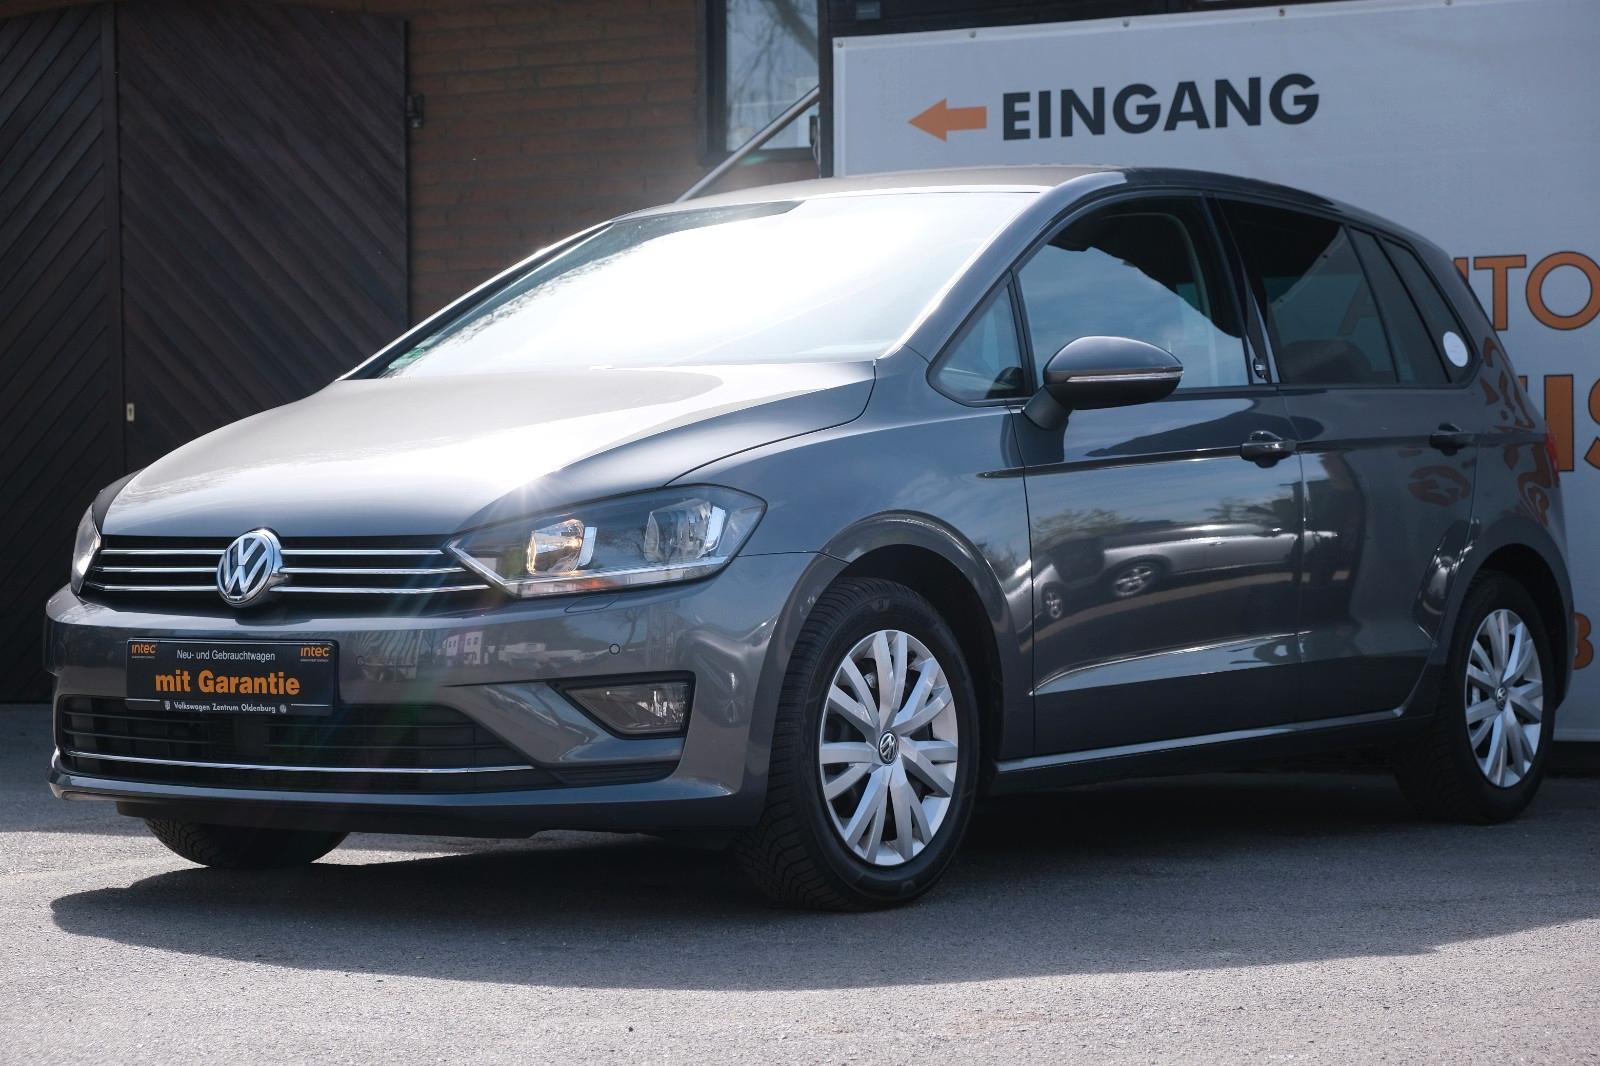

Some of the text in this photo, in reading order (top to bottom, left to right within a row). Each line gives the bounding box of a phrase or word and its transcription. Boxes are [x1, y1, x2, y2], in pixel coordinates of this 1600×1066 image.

[1002, 72, 1320, 141] EINGANG
[1453, 250, 1600, 331] TO
[176, 649, 276, 662] Neu- und Gebrauchtwagen
[155, 669, 301, 695] mit Garantie
[173, 701, 276, 713] Volkswagen Zentrum Oldenburg
